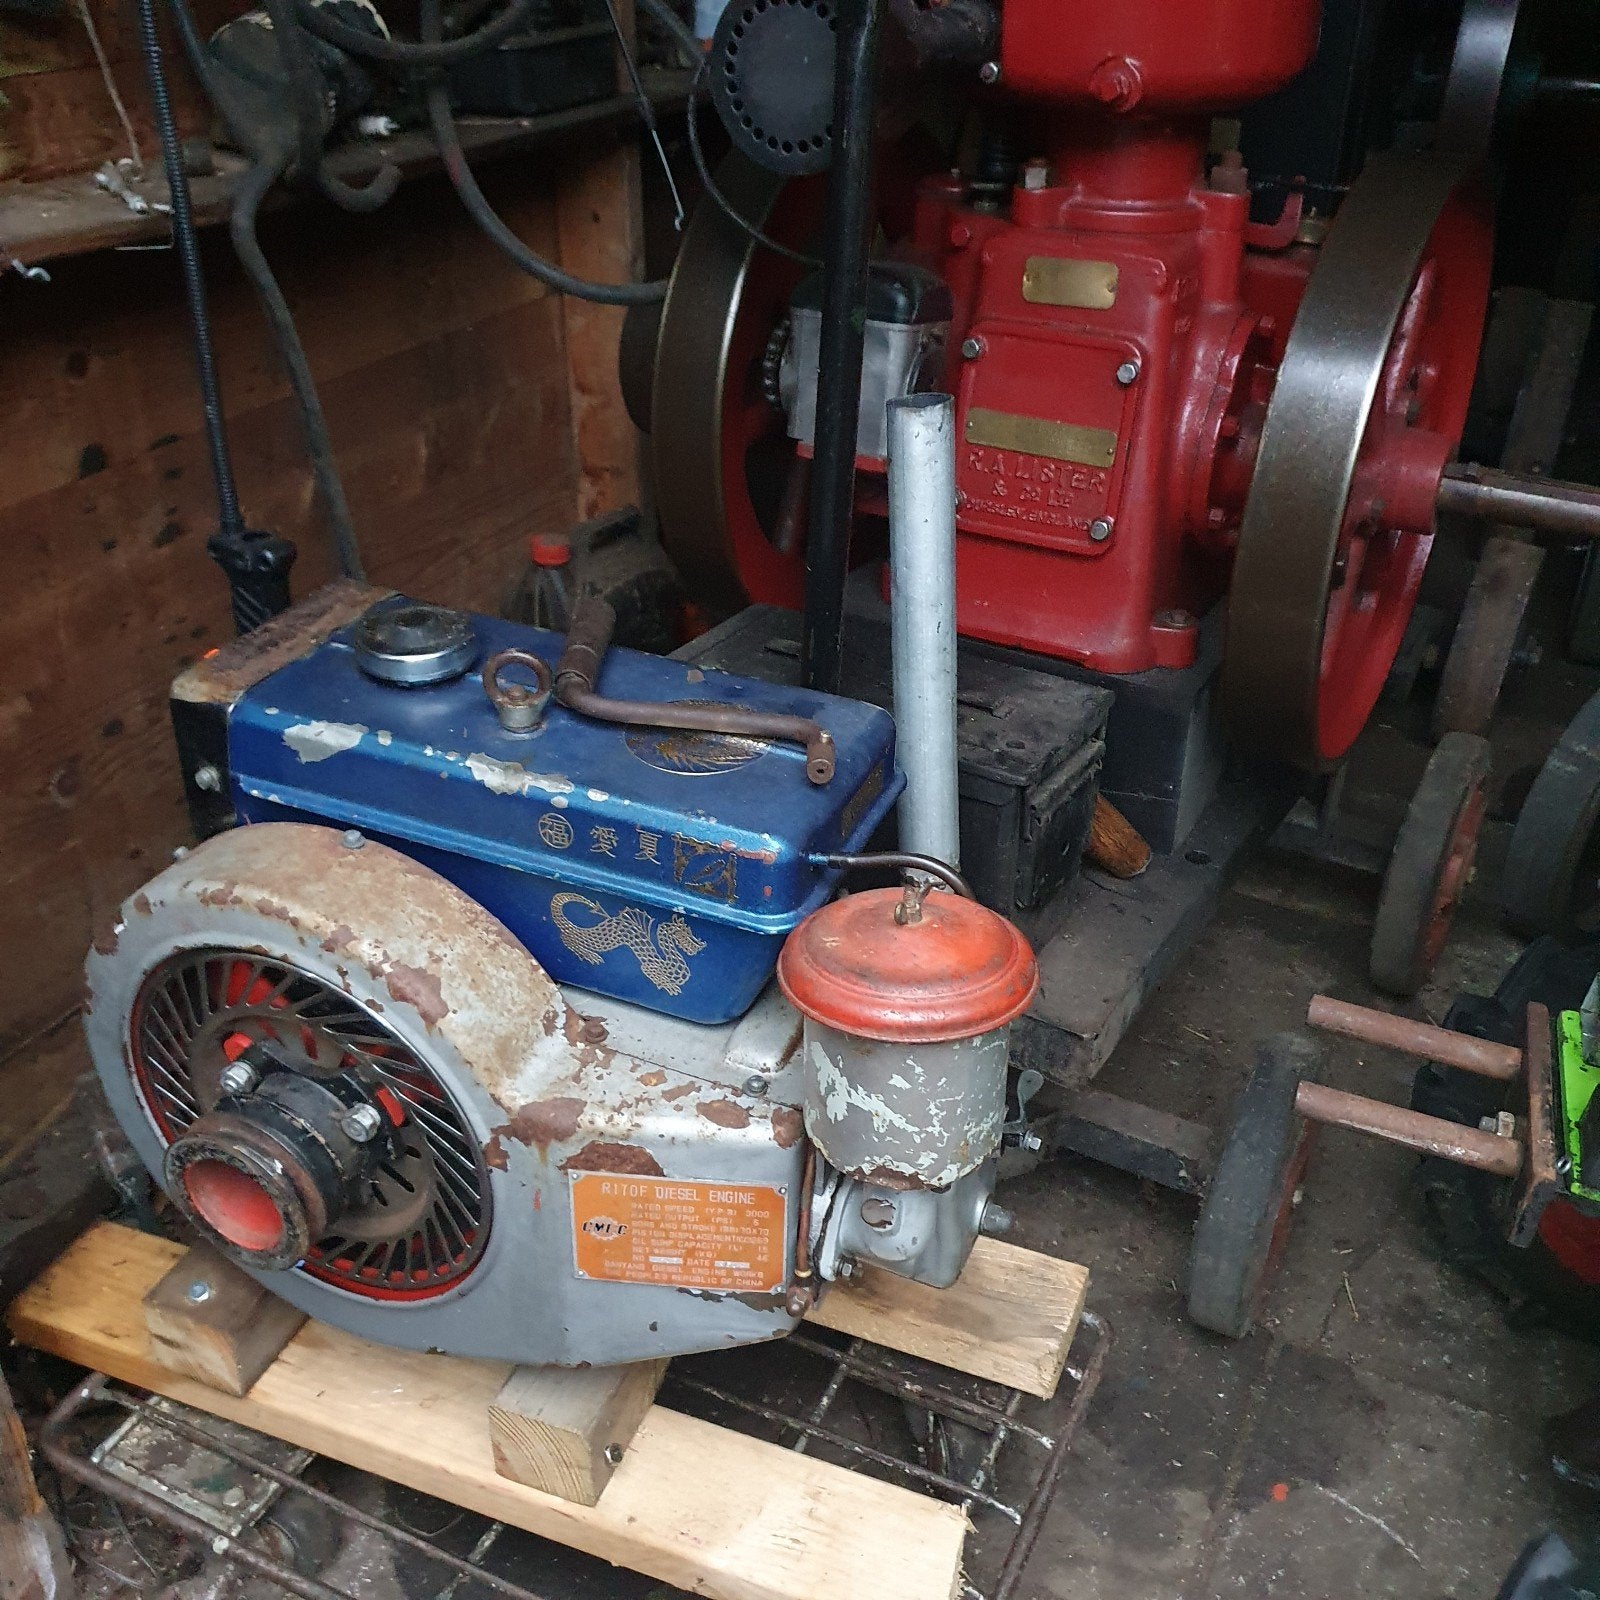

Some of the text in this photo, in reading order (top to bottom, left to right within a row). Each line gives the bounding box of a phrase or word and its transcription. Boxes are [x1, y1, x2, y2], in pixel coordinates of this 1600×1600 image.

[1015, 454, 1106, 493] LISTER
[654, 1185, 702, 1202] DIESEL
[709, 1189, 757, 1205] ENGINE
[665, 1204, 695, 1213] SPEED
[659, 1222, 678, 1230] AND
[678, 1240, 722, 1250] CAPACITY
[687, 1259, 711, 1267] DATE
[651, 1264, 683, 1273] DIESEL
[692, 1267, 727, 1276] ENGINE
[671, 1274, 718, 1284] REPUBLIC
[736, 1277, 764, 1287] CHINA
